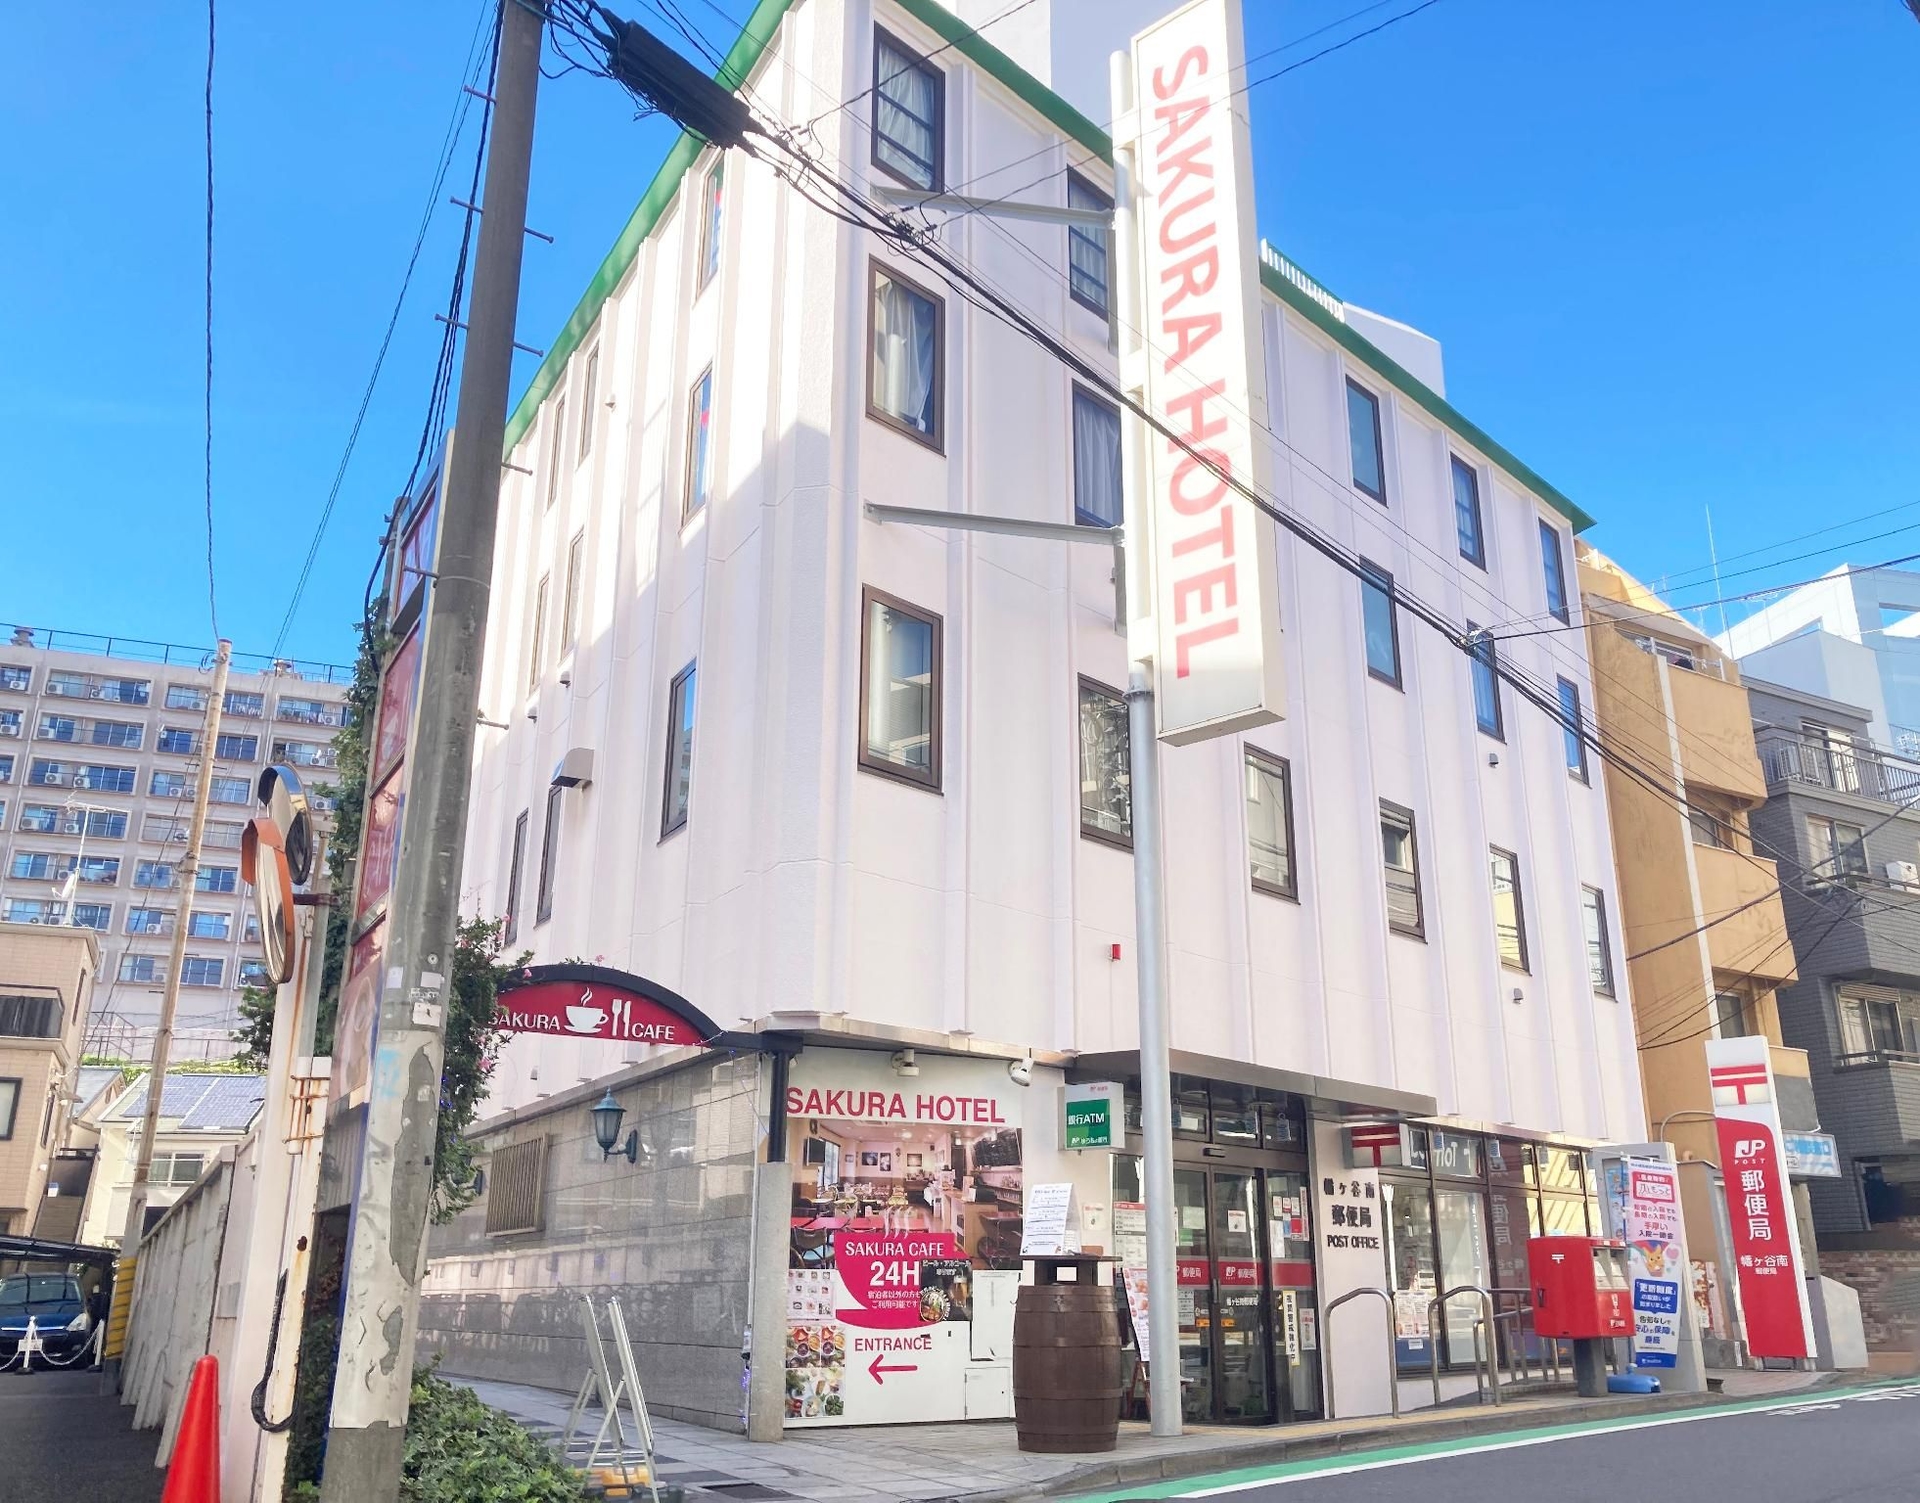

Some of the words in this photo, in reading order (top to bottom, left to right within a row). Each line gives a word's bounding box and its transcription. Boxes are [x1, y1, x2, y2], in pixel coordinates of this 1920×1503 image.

[1153, 44, 1223, 374] SAKURA
[1163, 379, 1240, 680] HOTEL
[488, 1011, 560, 1030] SAKURA
[631, 1022, 675, 1041] CAFE
[786, 1086, 906, 1119] SAKURA
[916, 1094, 1006, 1124] HOTEL
[1068, 1112, 1105, 1125] 銀行ATM
[1734, 1157, 1766, 1165] POST
[1740, 1169, 1772, 1241] 郵便局
[1331, 1204, 1372, 1228] 郵便局
[1644, 1221, 1668, 1231] 手厚い
[845, 1241, 904, 1257] SAKURA
[908, 1242, 945, 1257] CAFE
[1327, 1234, 1348, 1248] POST
[1350, 1235, 1380, 1250] OFFICE
[869, 1260, 920, 1287] 24H
[1182, 1265, 1203, 1279] 郵便局
[1755, 1266, 1777, 1275] 郵便局
[854, 1335, 933, 1352] ENTRANCE
